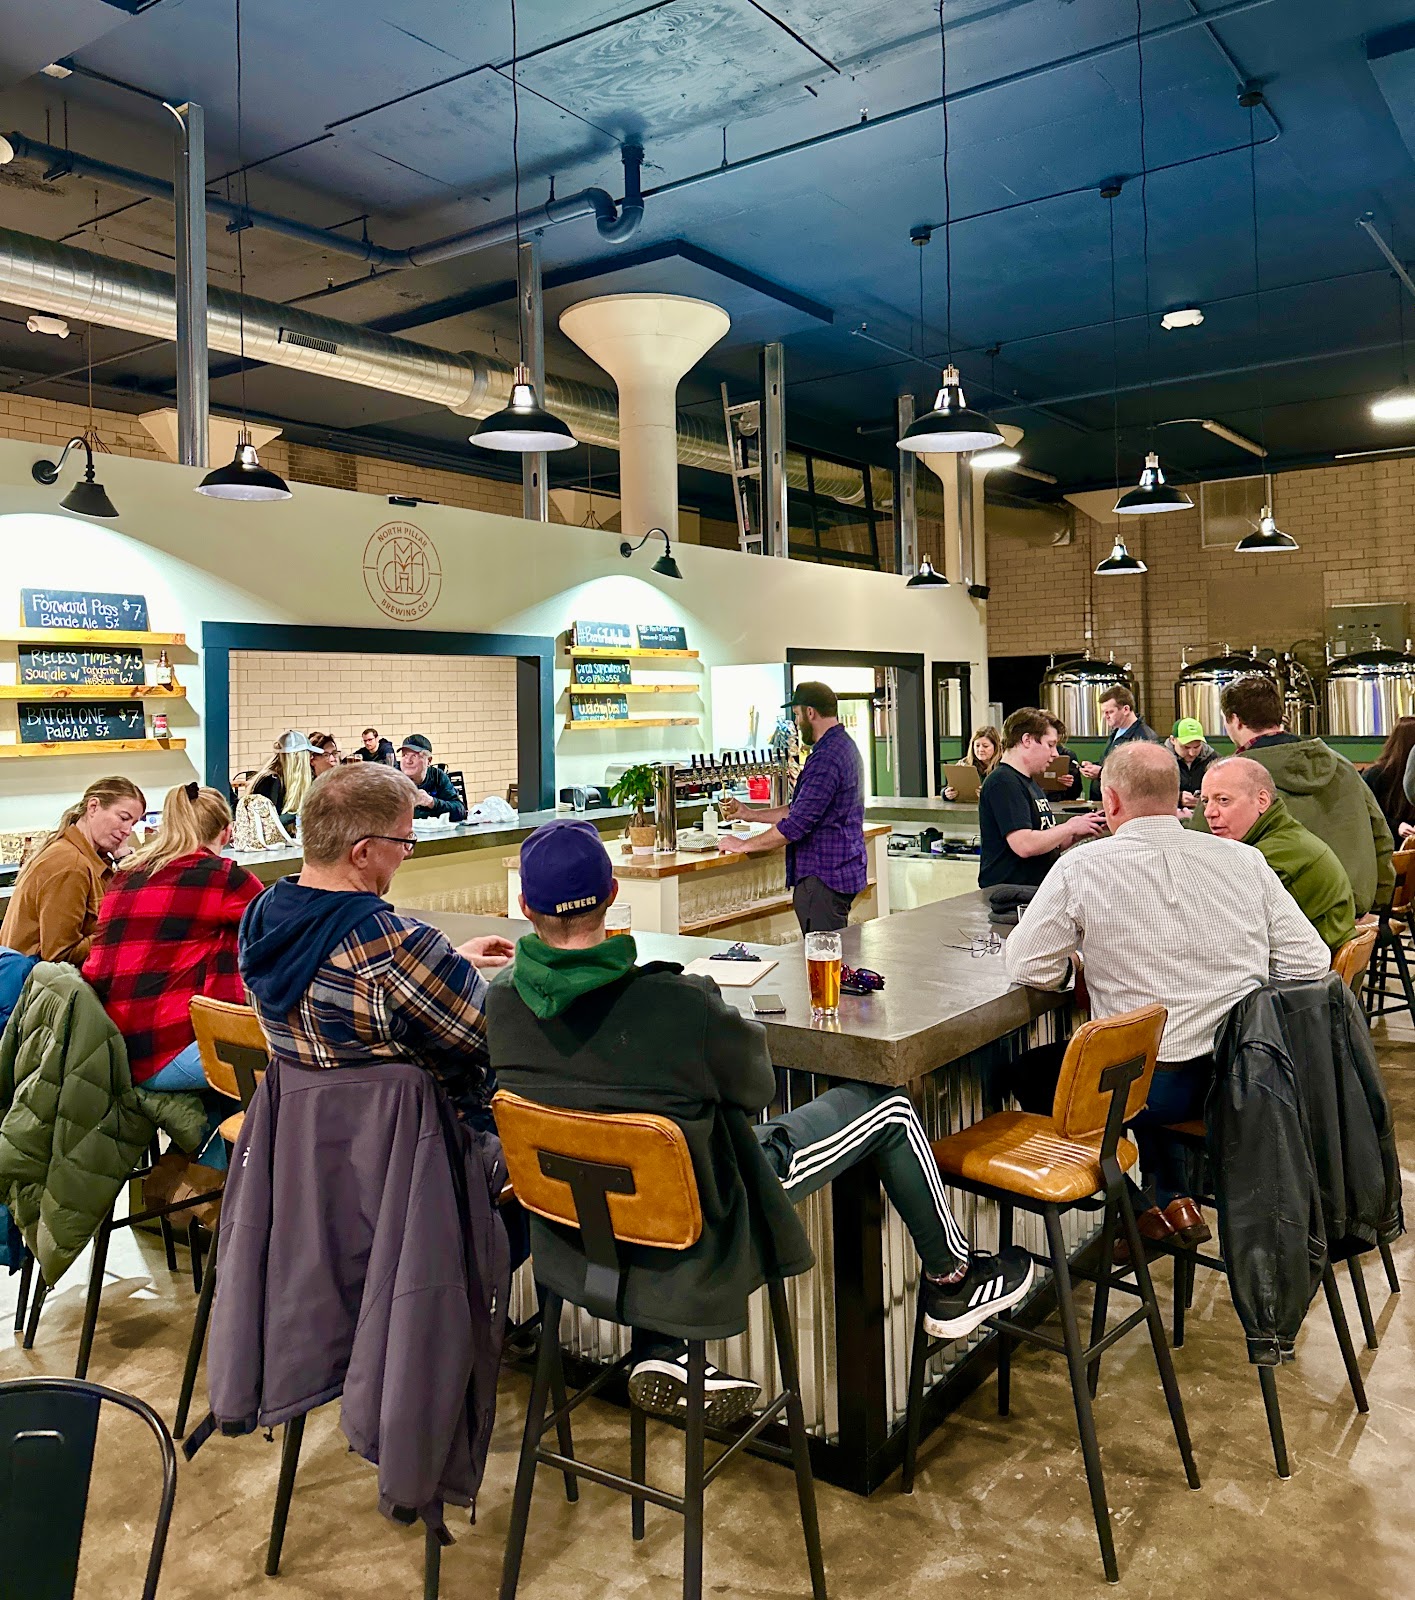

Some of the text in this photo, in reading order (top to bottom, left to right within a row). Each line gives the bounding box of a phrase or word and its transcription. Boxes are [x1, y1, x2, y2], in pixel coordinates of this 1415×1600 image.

[377, 526, 428, 548] NORTH PILLAR
[32, 593, 142, 621] Forward Pass $7
[380, 598, 429, 617] BREWING CO
[41, 613, 120, 629] Blonde Ale 5%
[31, 649, 78, 667] RECESS
[50, 666, 68, 681] ale
[119, 671, 134, 684] 6%
[25, 707, 75, 726] BATCH
[79, 707, 107, 725] ONE
[71, 726, 89, 740] Ale
[95, 725, 110, 737] 5%
[555, 896, 596, 913] BREWERS
